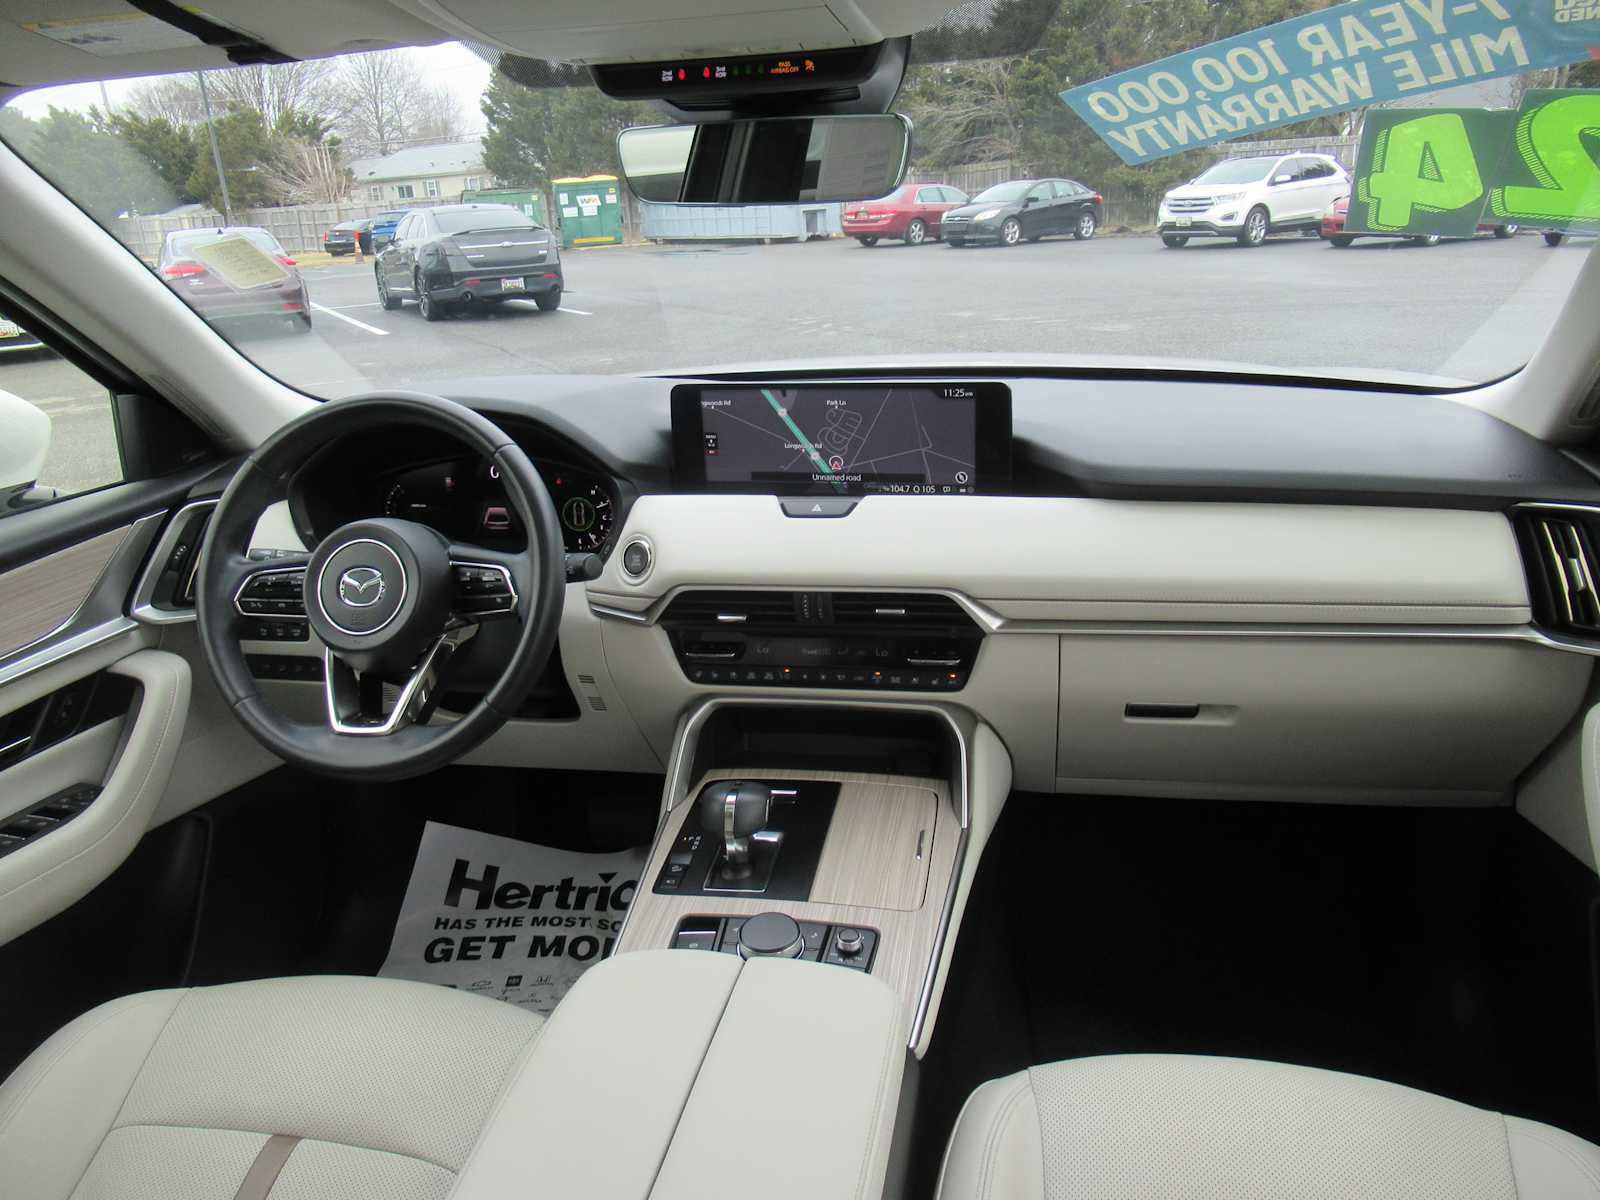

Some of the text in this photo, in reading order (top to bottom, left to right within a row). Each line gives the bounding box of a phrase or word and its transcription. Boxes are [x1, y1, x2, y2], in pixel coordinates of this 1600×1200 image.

[812, 473, 862, 481] Unnamed road
[890, 485, 909, 493] 104.7
[922, 484, 936, 493] 105
[434, 916, 478, 930] HAS
[485, 916, 525, 930] THE
[531, 915, 591, 929] MOST
[424, 935, 516, 963] GET
